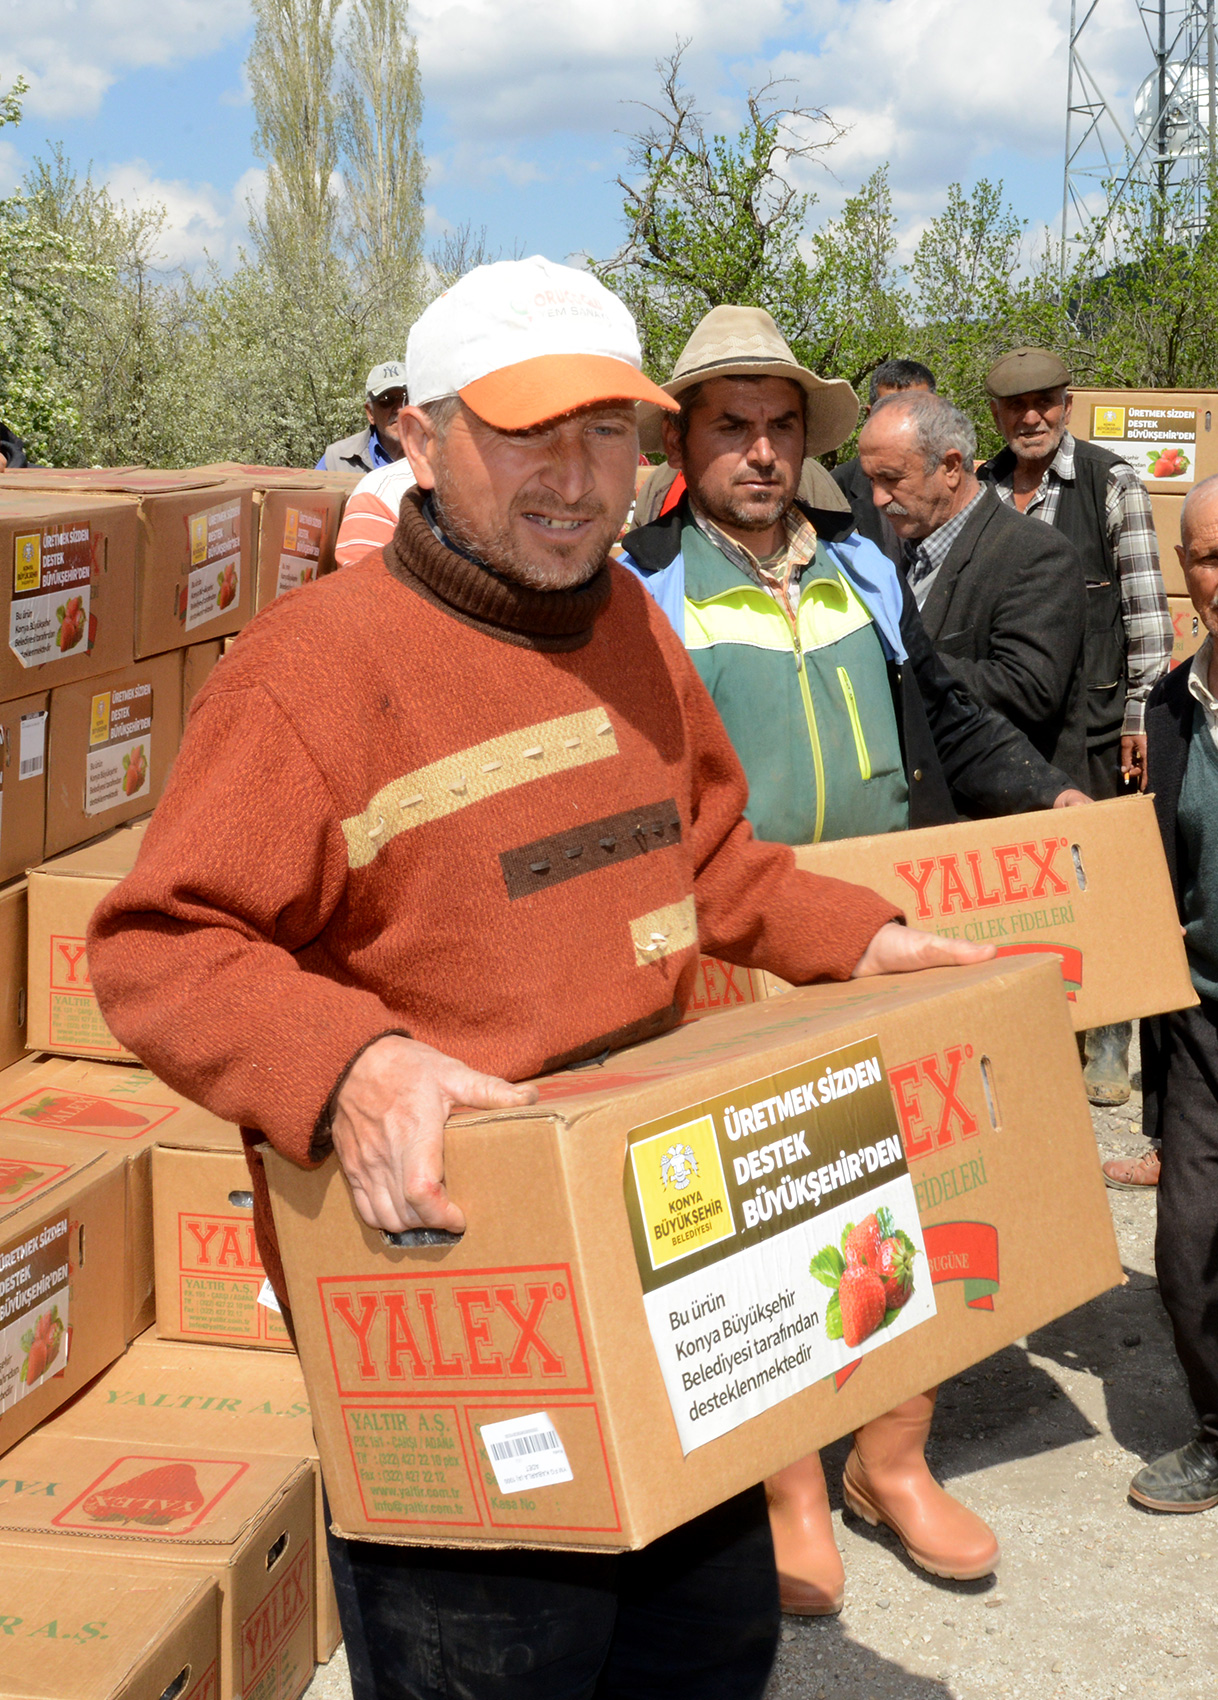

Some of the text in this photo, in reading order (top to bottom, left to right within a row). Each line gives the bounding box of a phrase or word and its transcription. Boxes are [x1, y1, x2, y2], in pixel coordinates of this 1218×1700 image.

[1128, 408, 1195, 419] ÜRETMEK SİZDEN
[1128, 420, 1158, 428] DESTEK
[1127, 429, 1195, 440] BÜYÜKŞEHİR'DEN
[42, 552, 64, 568] DESTEK
[893, 837, 1070, 920] YALEX
[1010, 900, 1075, 936] FİDELERİ
[723, 1081, 820, 1141] ÜRETMEK
[817, 1056, 882, 1104] SİZDEN
[732, 1130, 811, 1186] DESTEK
[742, 1134, 903, 1229] BÜYÜKŞEHİR'DEN
[913, 1150, 988, 1213] FİDELERİ
[668, 1190, 703, 1214] KONYA
[39, 1218, 68, 1249] SİZDEN
[654, 1199, 723, 1240] BÜYÜKŞEHİR
[186, 1221, 265, 1270] YAL
[185, 1279, 225, 1292] YALTIR
[669, 1293, 726, 1331] Bu ürün
[675, 1288, 796, 1361] Konya Büyükşehir
[330, 1282, 567, 1381] YALEX
[681, 1311, 820, 1392] Belediyesi tarafından
[689, 1343, 812, 1422] desteklenmektedir
[105, 1390, 243, 1413] YALTIR
[350, 1413, 410, 1431] YALTIR
[418, 1413, 450, 1437] A.Ş.
[402, 1453, 416, 1466] 427
[418, 1454, 430, 1466] 22
[406, 1470, 420, 1482] 427
[422, 1470, 434, 1483] 22
[370, 1486, 460, 1499] www.yaltir.com.tr
[490, 1497, 518, 1510] Kasa
[520, 1498, 536, 1511] No
[27, 1619, 109, 1645] A.Ş.
